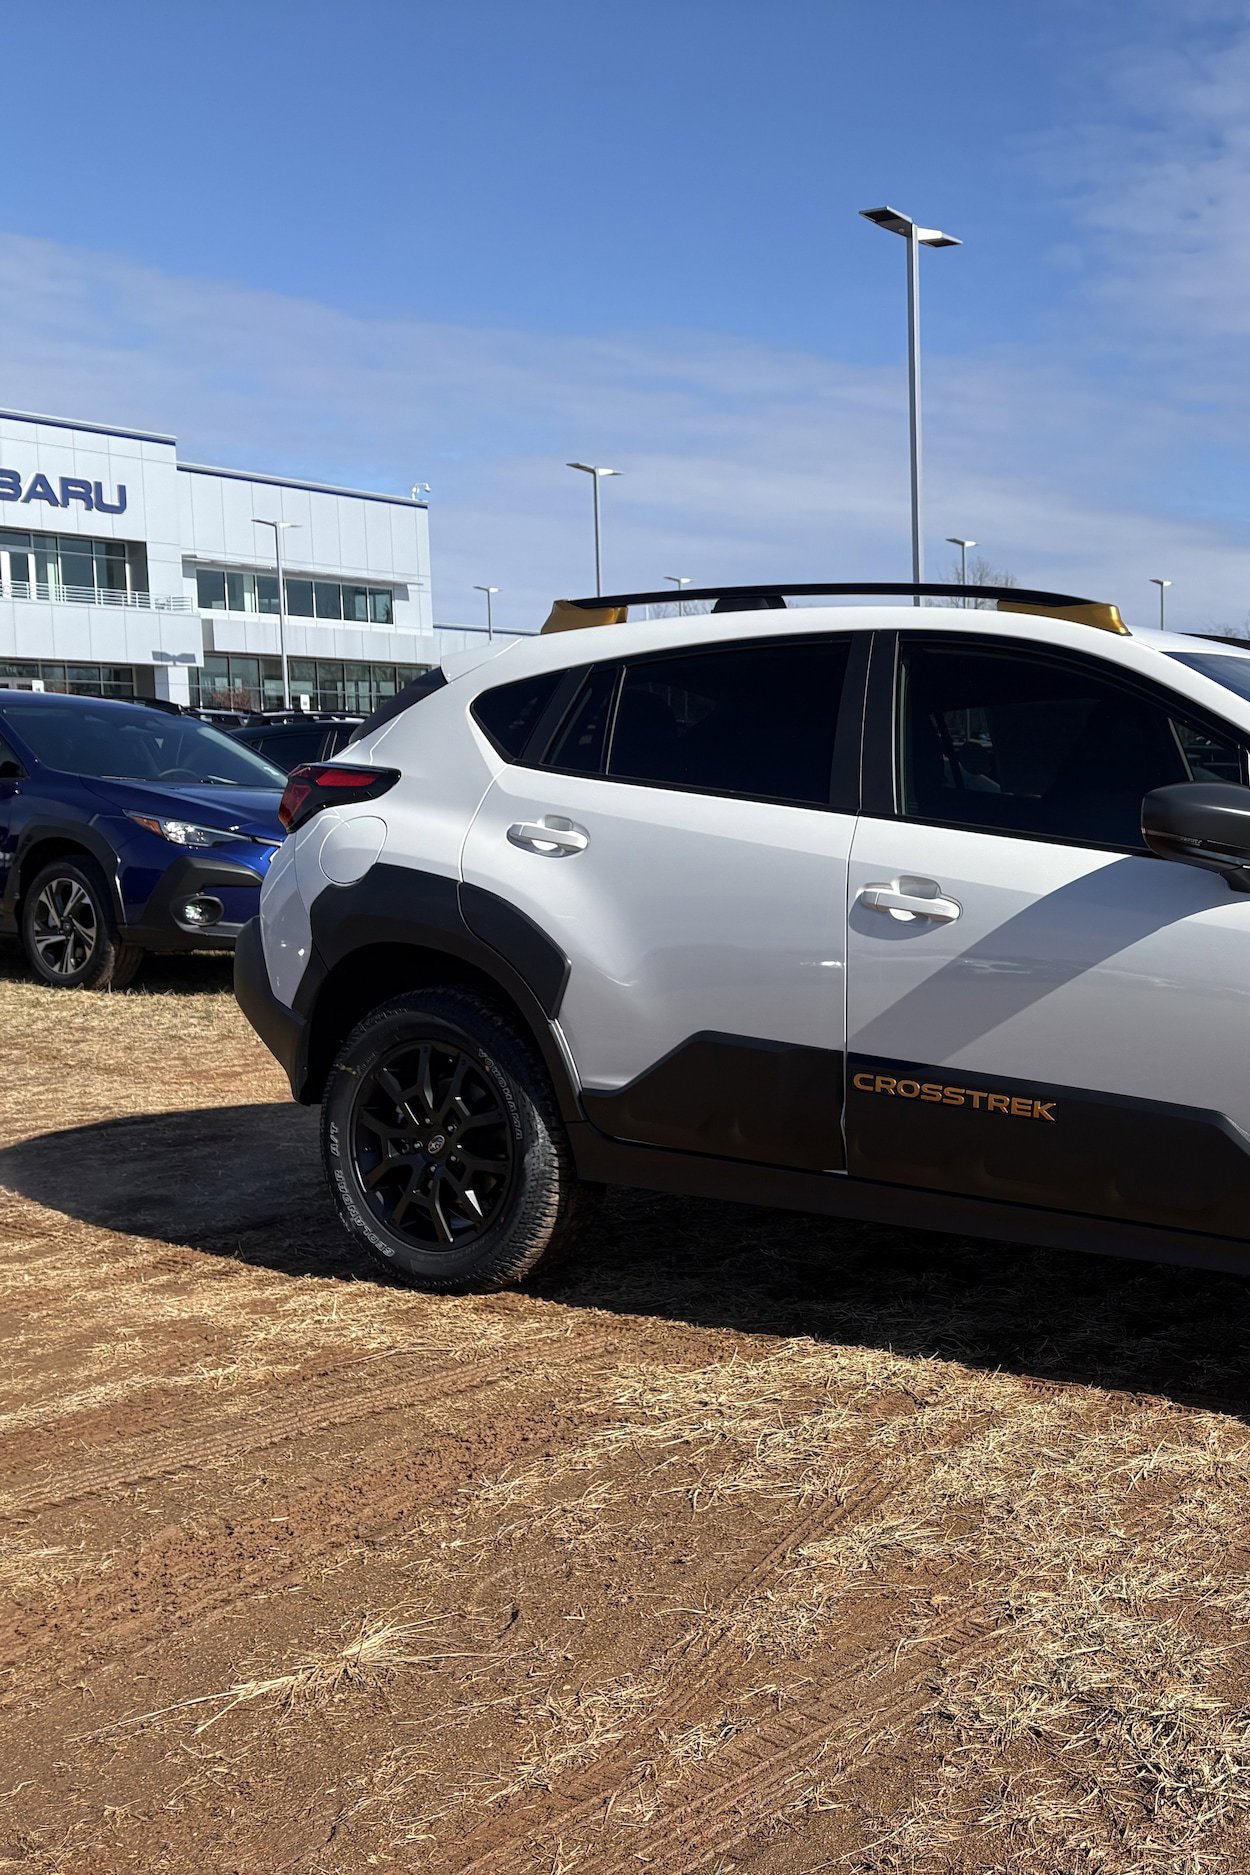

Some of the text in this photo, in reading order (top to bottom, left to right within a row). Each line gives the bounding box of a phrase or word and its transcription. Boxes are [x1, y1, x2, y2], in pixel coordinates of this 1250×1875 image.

[853, 1072, 1057, 1122] CROSSTREK
[330, 1121, 396, 1258] GEOLANDAR A/T
